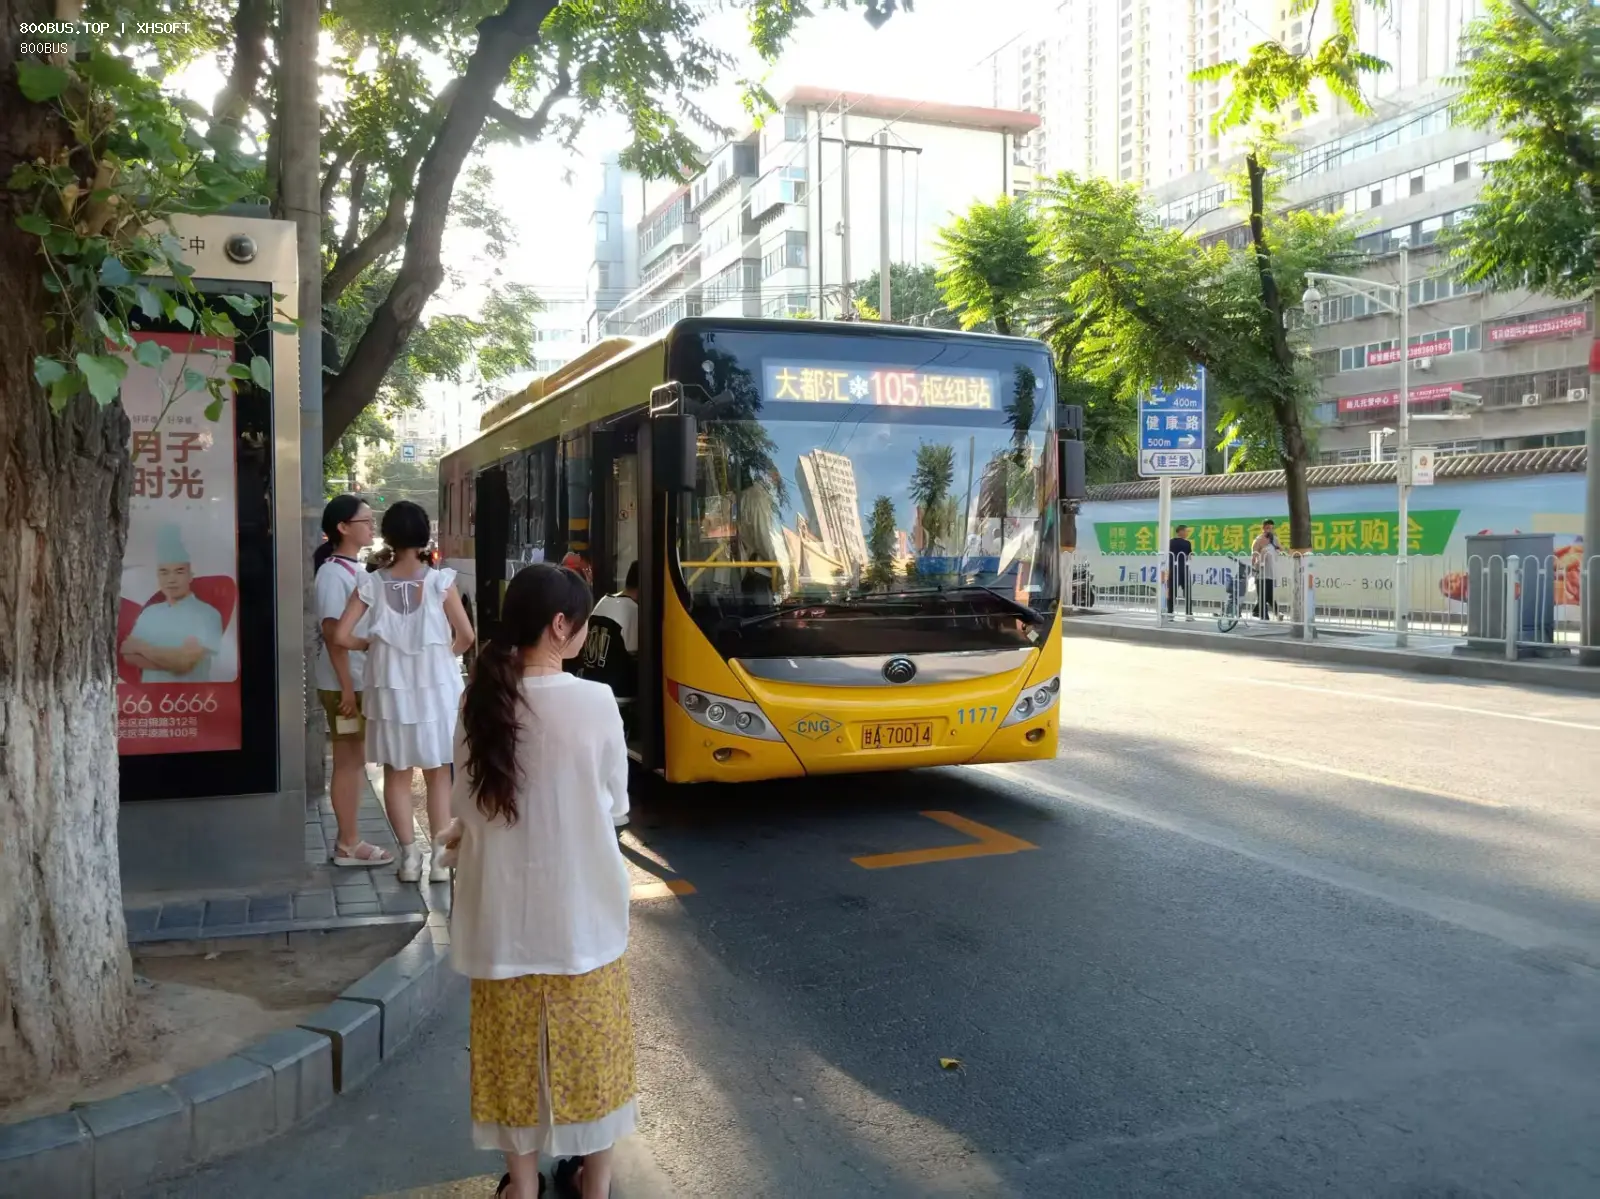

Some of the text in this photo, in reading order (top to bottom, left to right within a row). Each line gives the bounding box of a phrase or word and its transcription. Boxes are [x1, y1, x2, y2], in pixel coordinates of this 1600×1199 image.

[776, 368, 991, 409] 大都汇 105 枢纽站
[1173, 398, 1197, 407] 400m
[1146, 415, 1199, 431] 健康路
[133, 431, 204, 463] 月子
[1148, 438, 1171, 447] 500m
[133, 466, 204, 499] 时光
[117, 693, 218, 714] 66 6666
[957, 706, 998, 724] 1177
[797, 719, 830, 733] CNG
